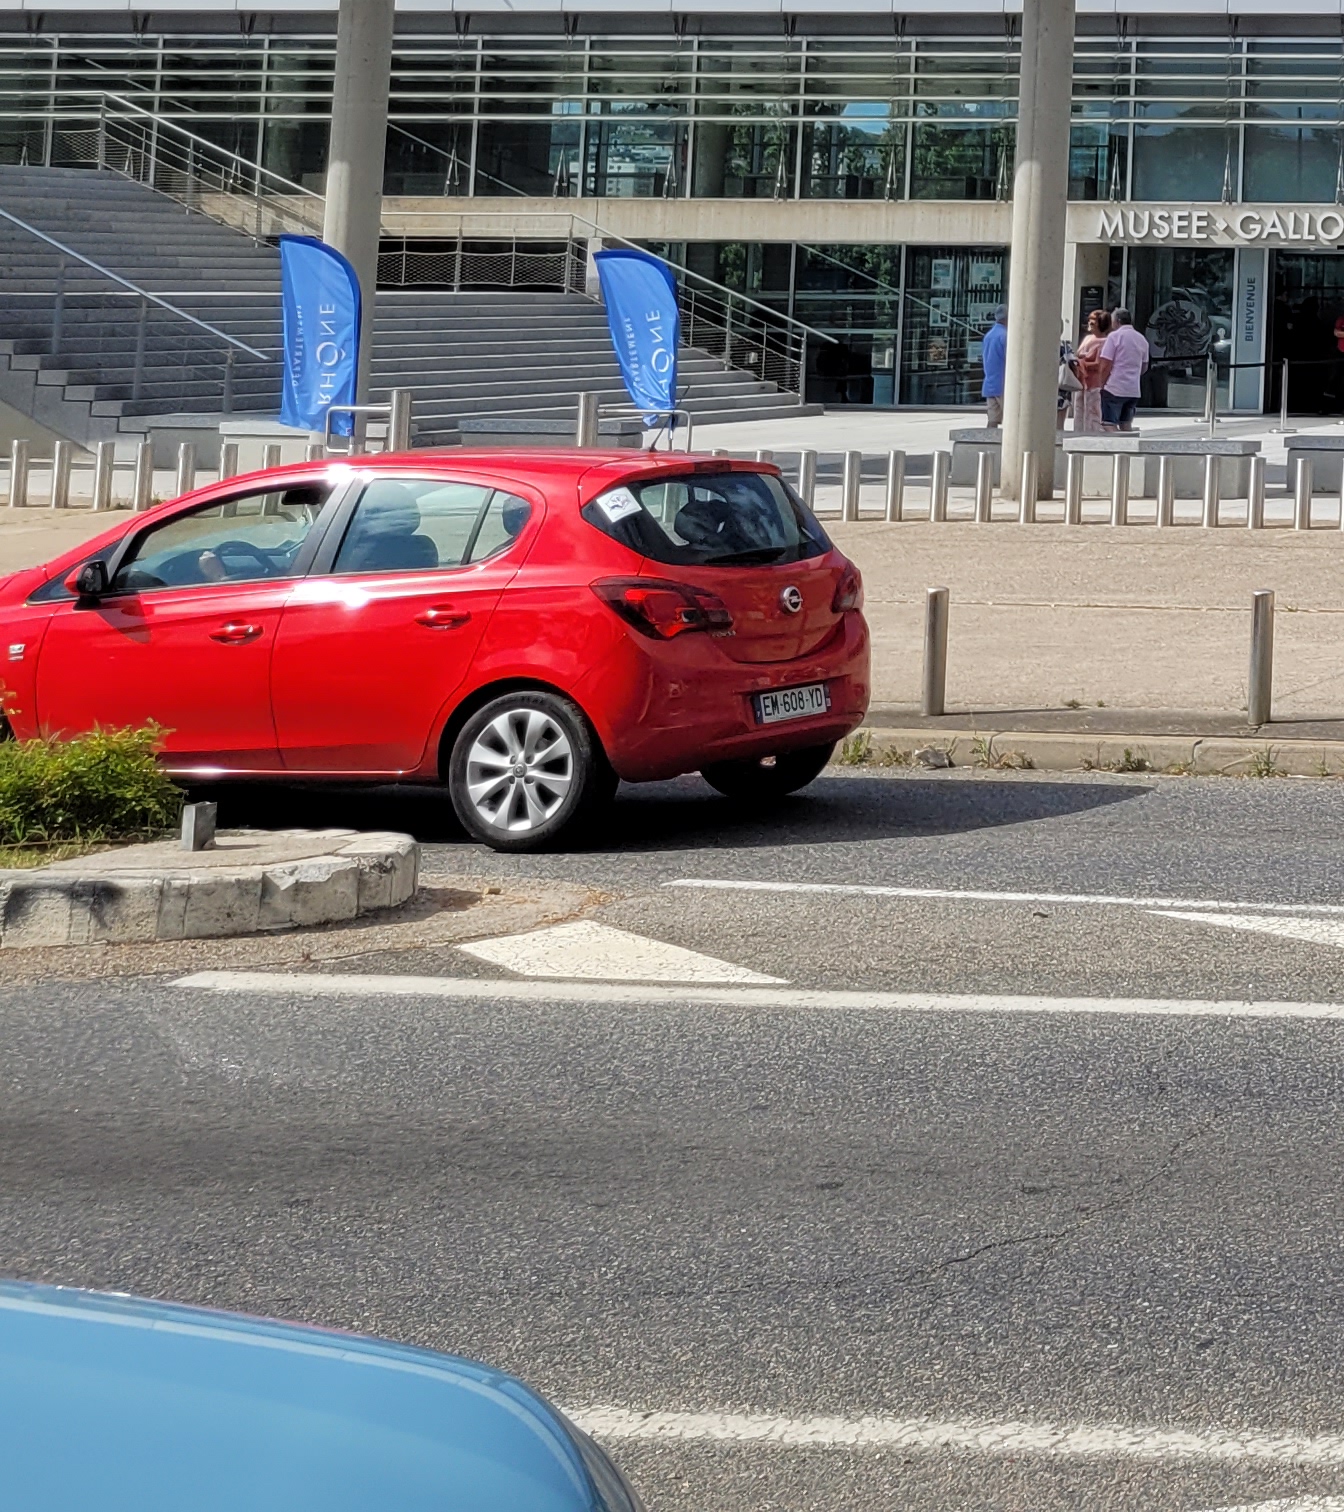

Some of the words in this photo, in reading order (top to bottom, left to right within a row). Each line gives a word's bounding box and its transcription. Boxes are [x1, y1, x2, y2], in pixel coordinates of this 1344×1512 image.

[1096, 209, 1209, 239] MUSEE
[1234, 210, 1344, 241] GALLO
[1244, 277, 1256, 342] BIENVENUE
[762, 688, 823, 717] EM-608-YD
